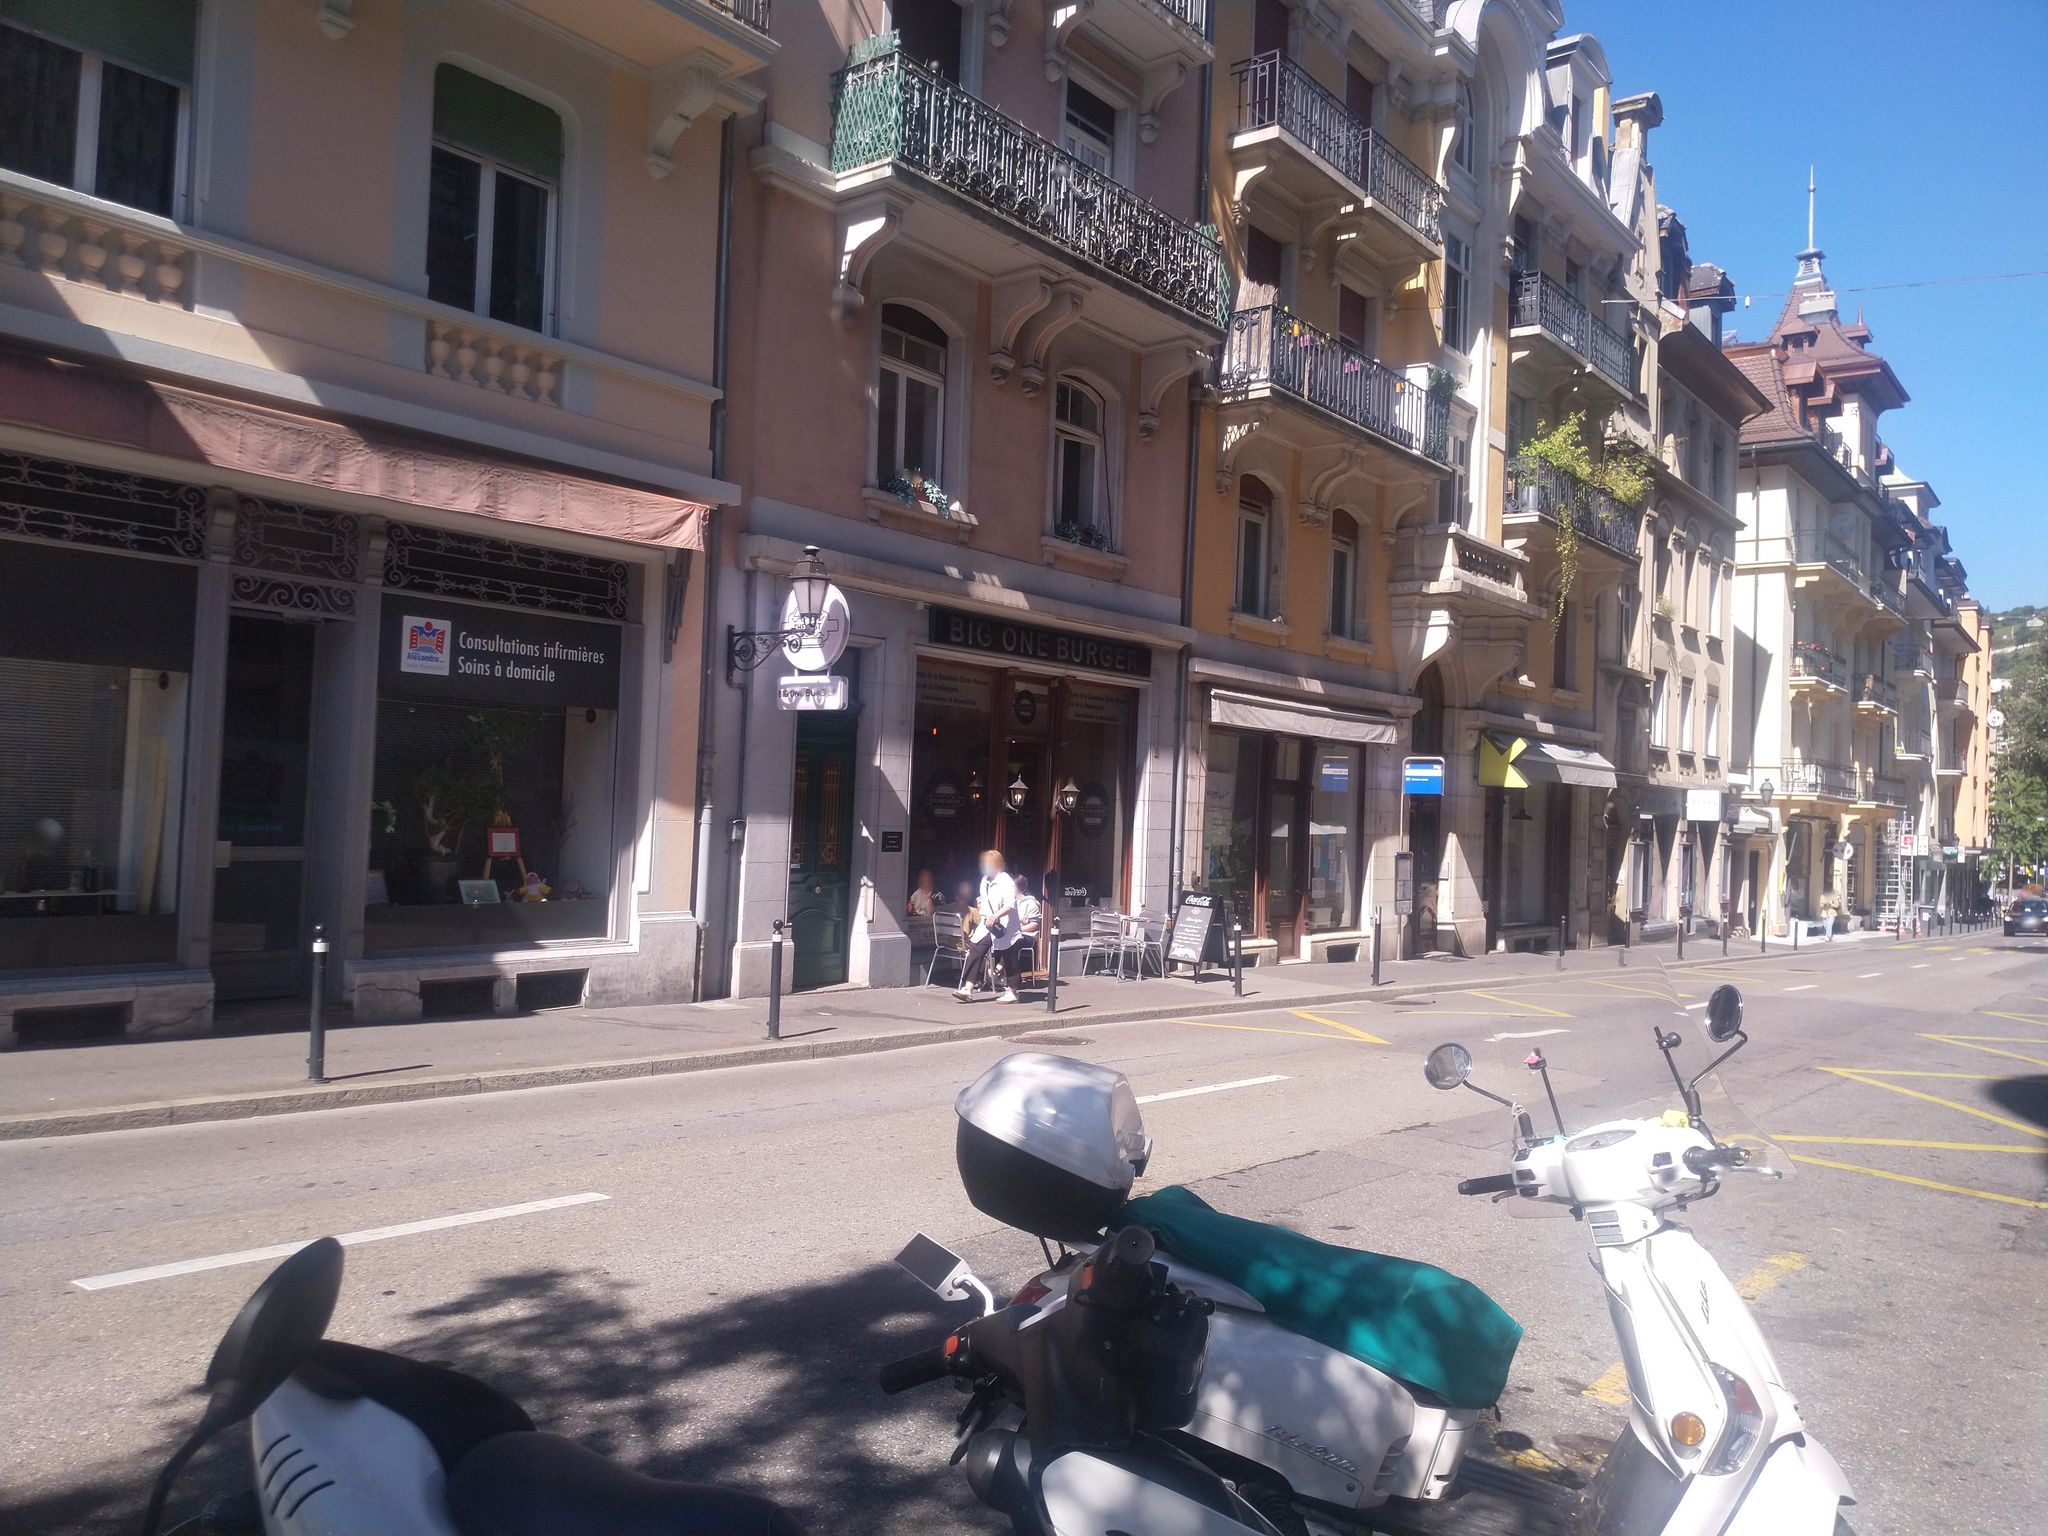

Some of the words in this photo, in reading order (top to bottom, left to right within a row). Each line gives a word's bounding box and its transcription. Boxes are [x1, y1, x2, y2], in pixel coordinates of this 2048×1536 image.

[458, 631, 540, 657] Consultations
[543, 641, 605, 664] infirmières
[950, 616, 993, 648] BIG
[1002, 627, 1049, 658] ONE
[1056, 636, 1138, 672] BURGER
[458, 656, 491, 677] Soins
[494, 660, 502, 678] à
[506, 660, 556, 682] domicile
